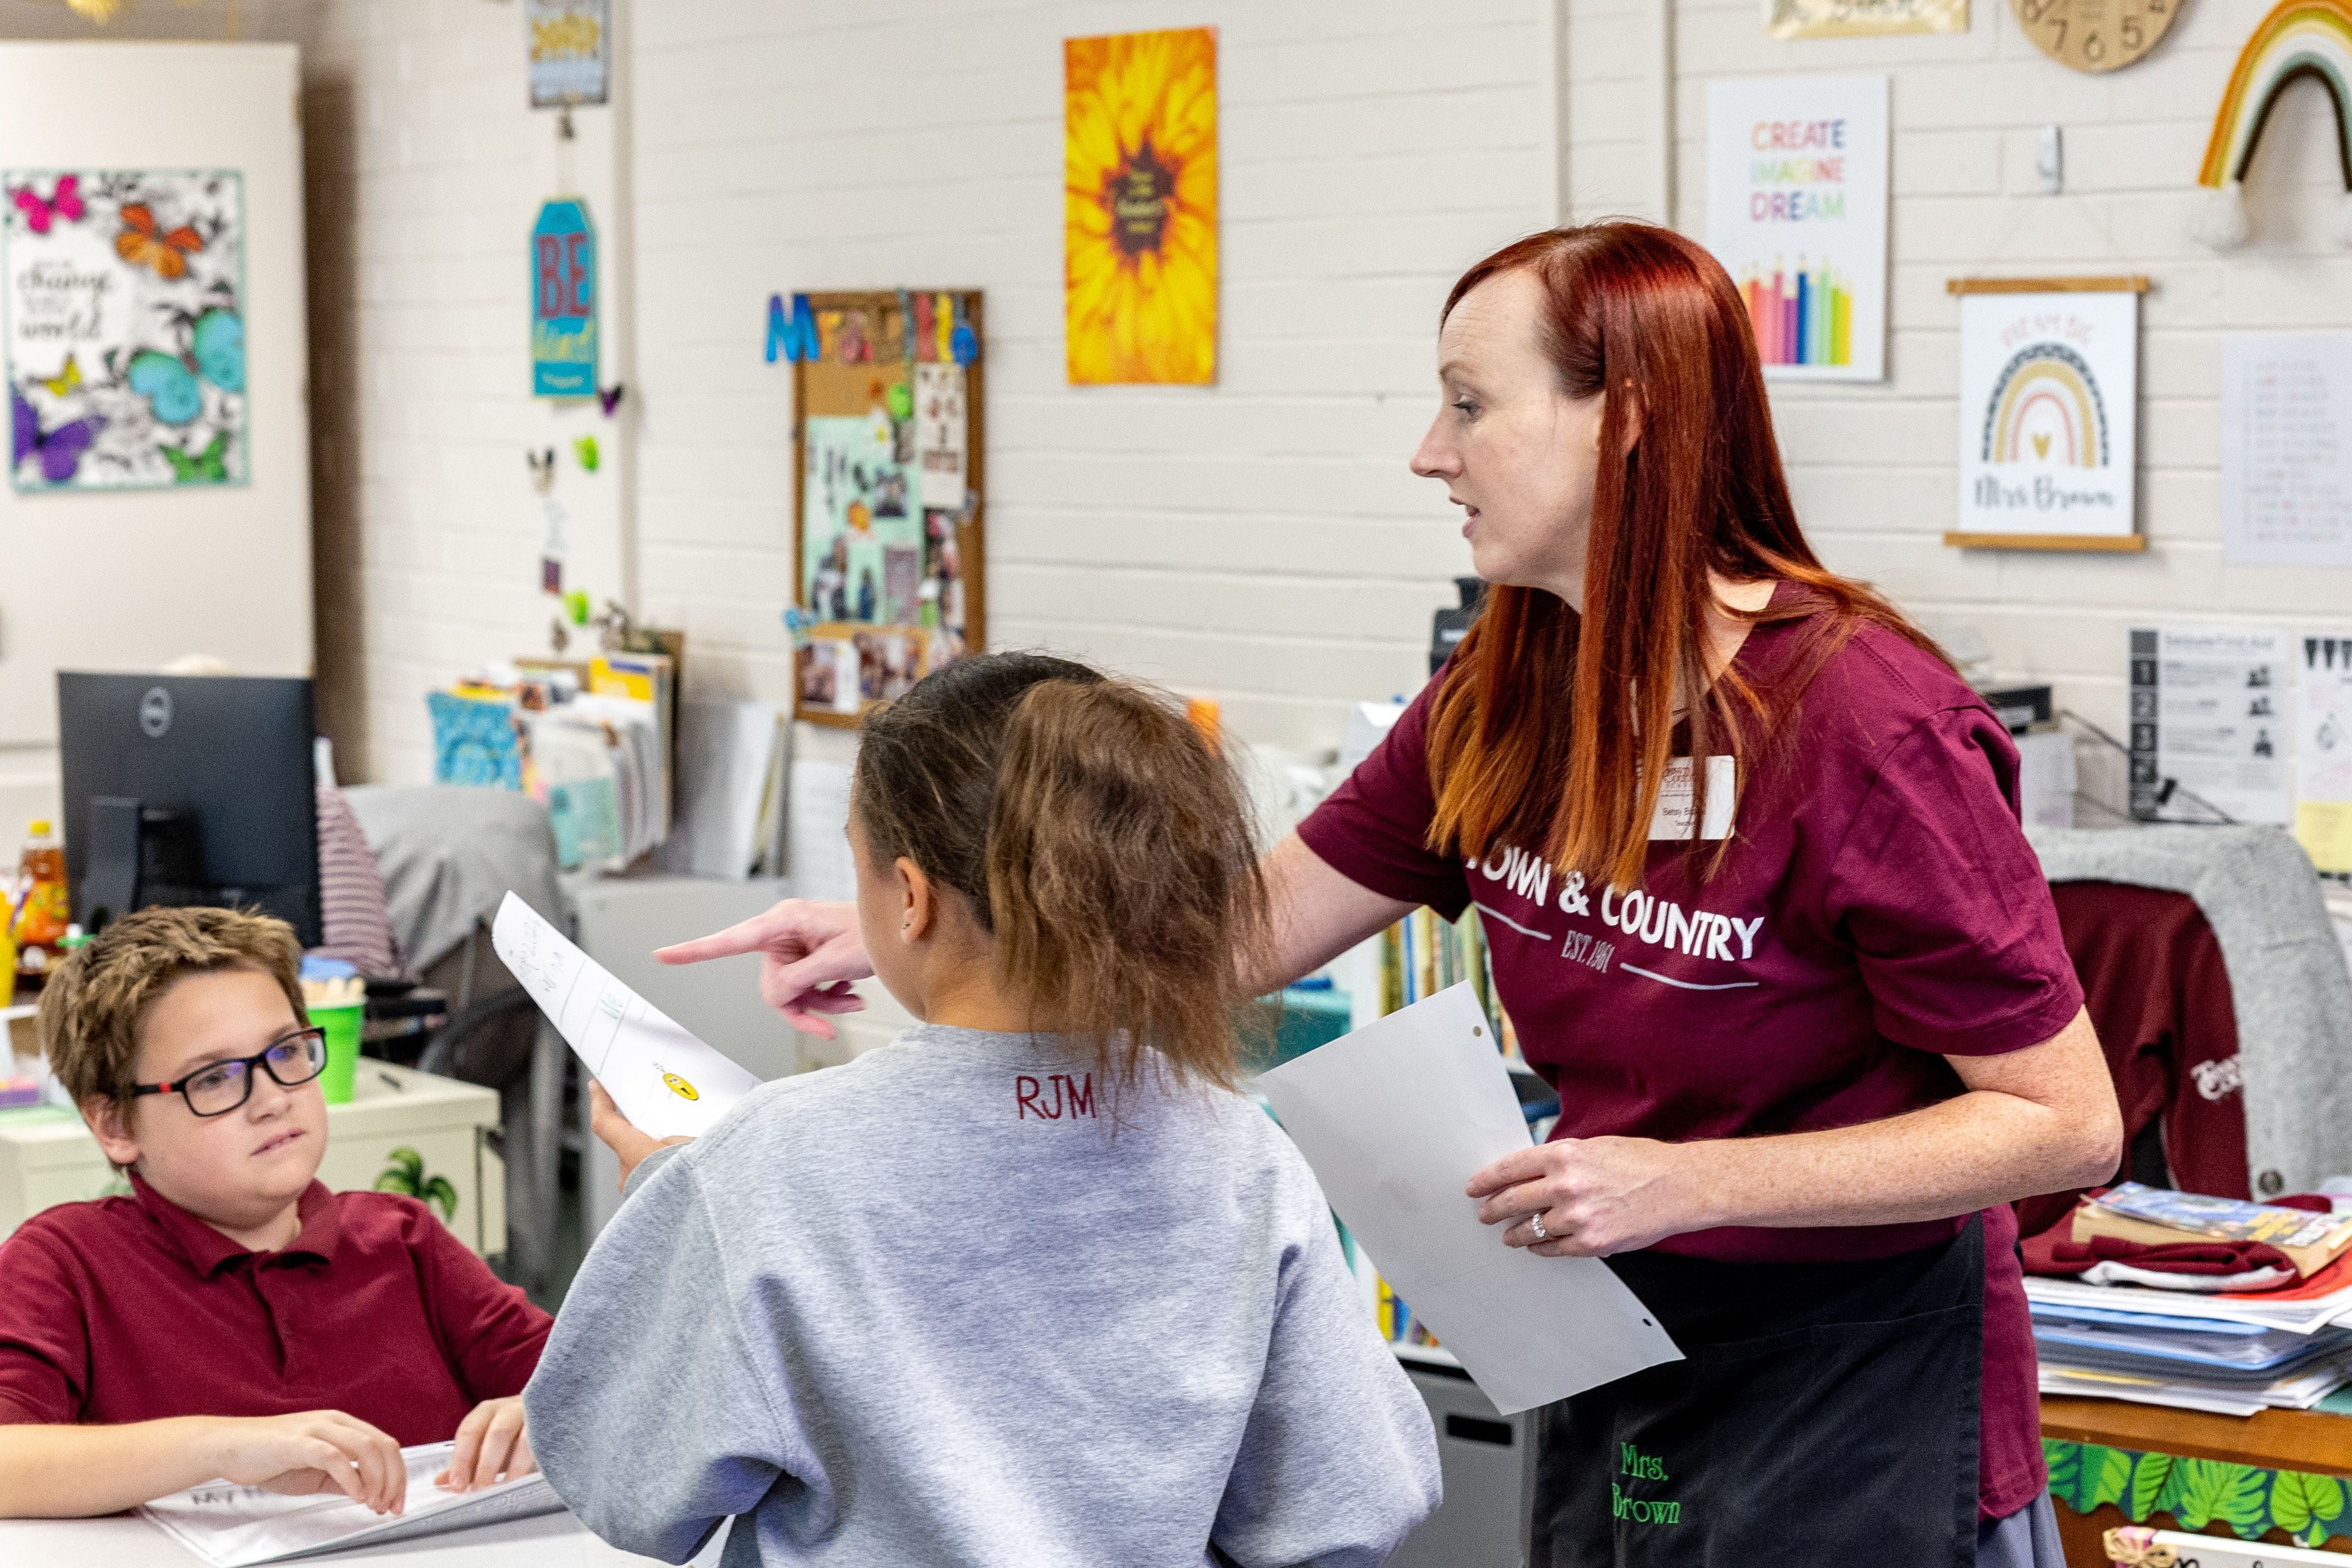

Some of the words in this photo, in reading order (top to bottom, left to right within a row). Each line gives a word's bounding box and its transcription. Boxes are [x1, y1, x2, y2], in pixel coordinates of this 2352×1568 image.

[2048, 18, 2067, 52] 7
[2082, 30, 2106, 63] 6
[2121, 14, 2142, 50] 5
[1751, 120, 1846, 151] CREATE
[1750, 156, 1845, 183] IMAGINE
[1750, 190, 1845, 222] DREAM
[537, 233, 589, 318] BE
[1466, 846, 1551, 906] OWN
[1558, 871, 1590, 917] &
[1601, 883, 1765, 961] COUNTRY
[1016, 1072, 1096, 1119] RJM
[1620, 1441, 1669, 1481] Mrs.
[1611, 1482, 1681, 1525] Brown
